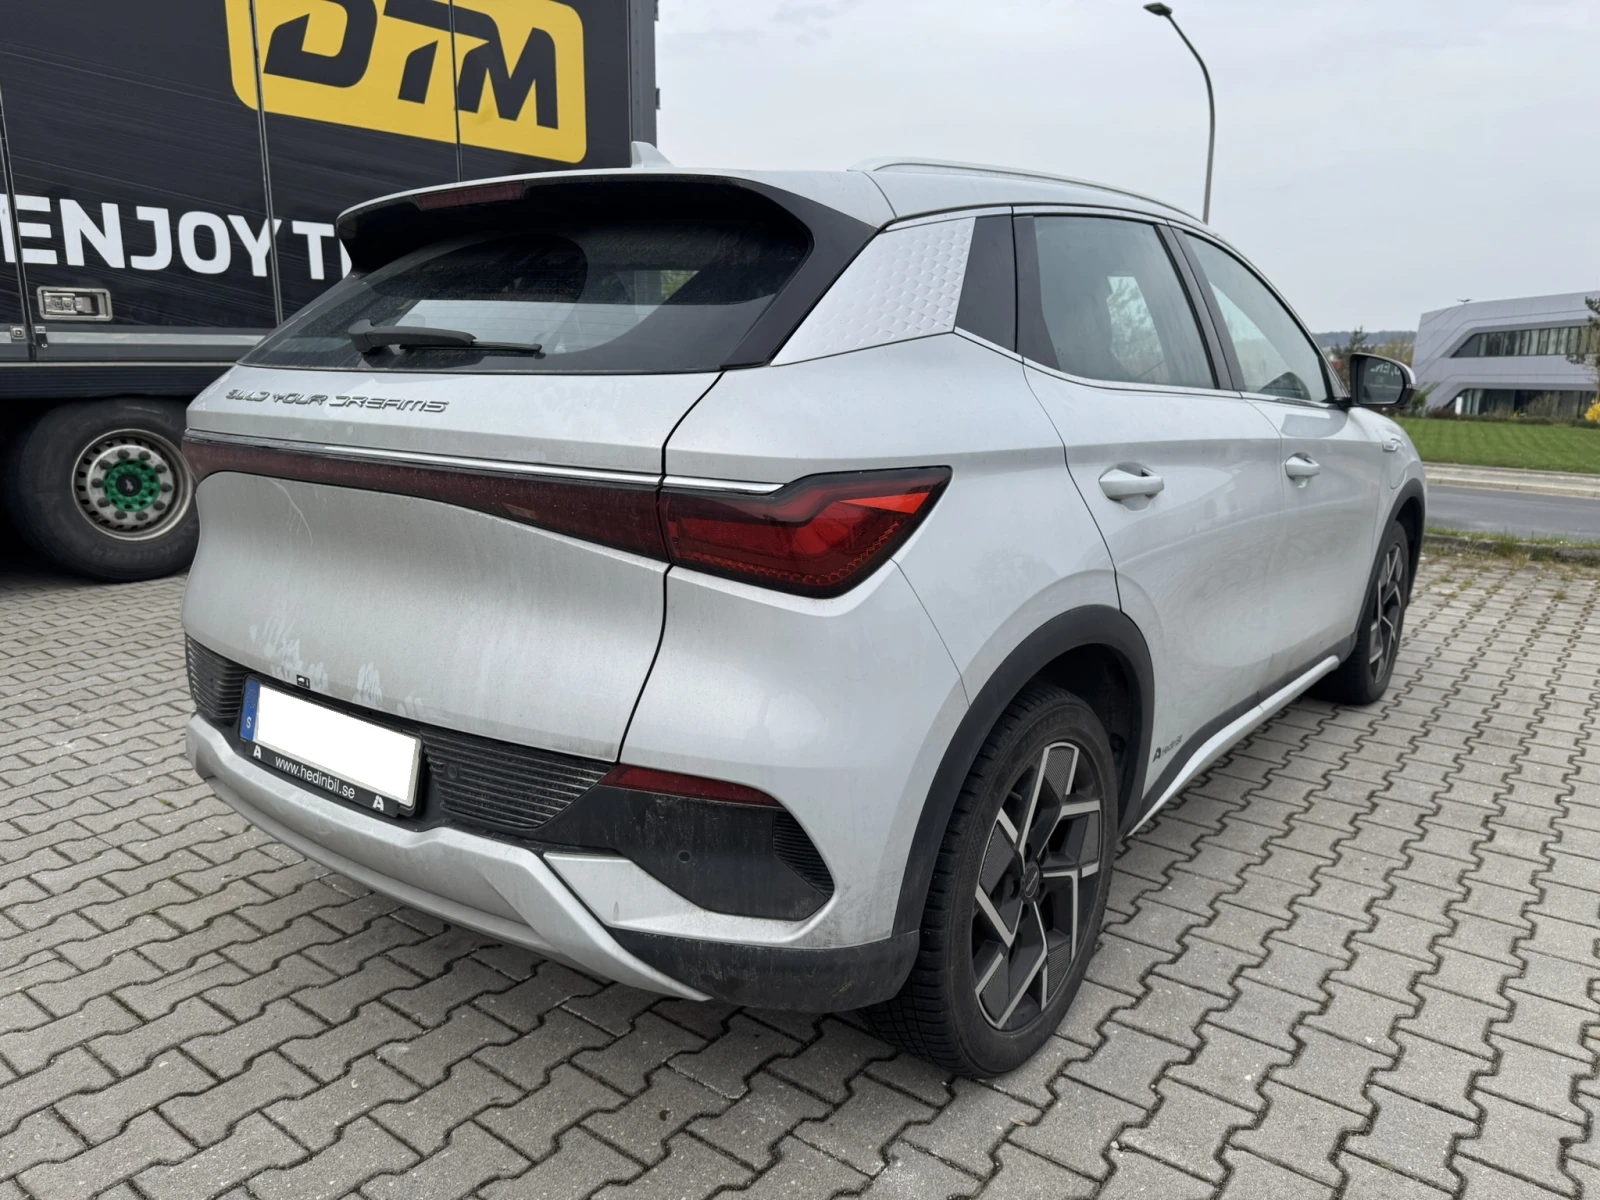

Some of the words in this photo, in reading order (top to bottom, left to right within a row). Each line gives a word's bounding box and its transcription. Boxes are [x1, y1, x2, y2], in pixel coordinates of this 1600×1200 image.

[263, 0, 559, 130] DTM
[0, 193, 283, 277] ENJOY
[291, 220, 352, 281] T
[272, 392, 329, 406] YOUR
[328, 394, 450, 413] DREAMS
[246, 717, 252, 729] S
[275, 756, 356, 799] www.hedinbil.se
